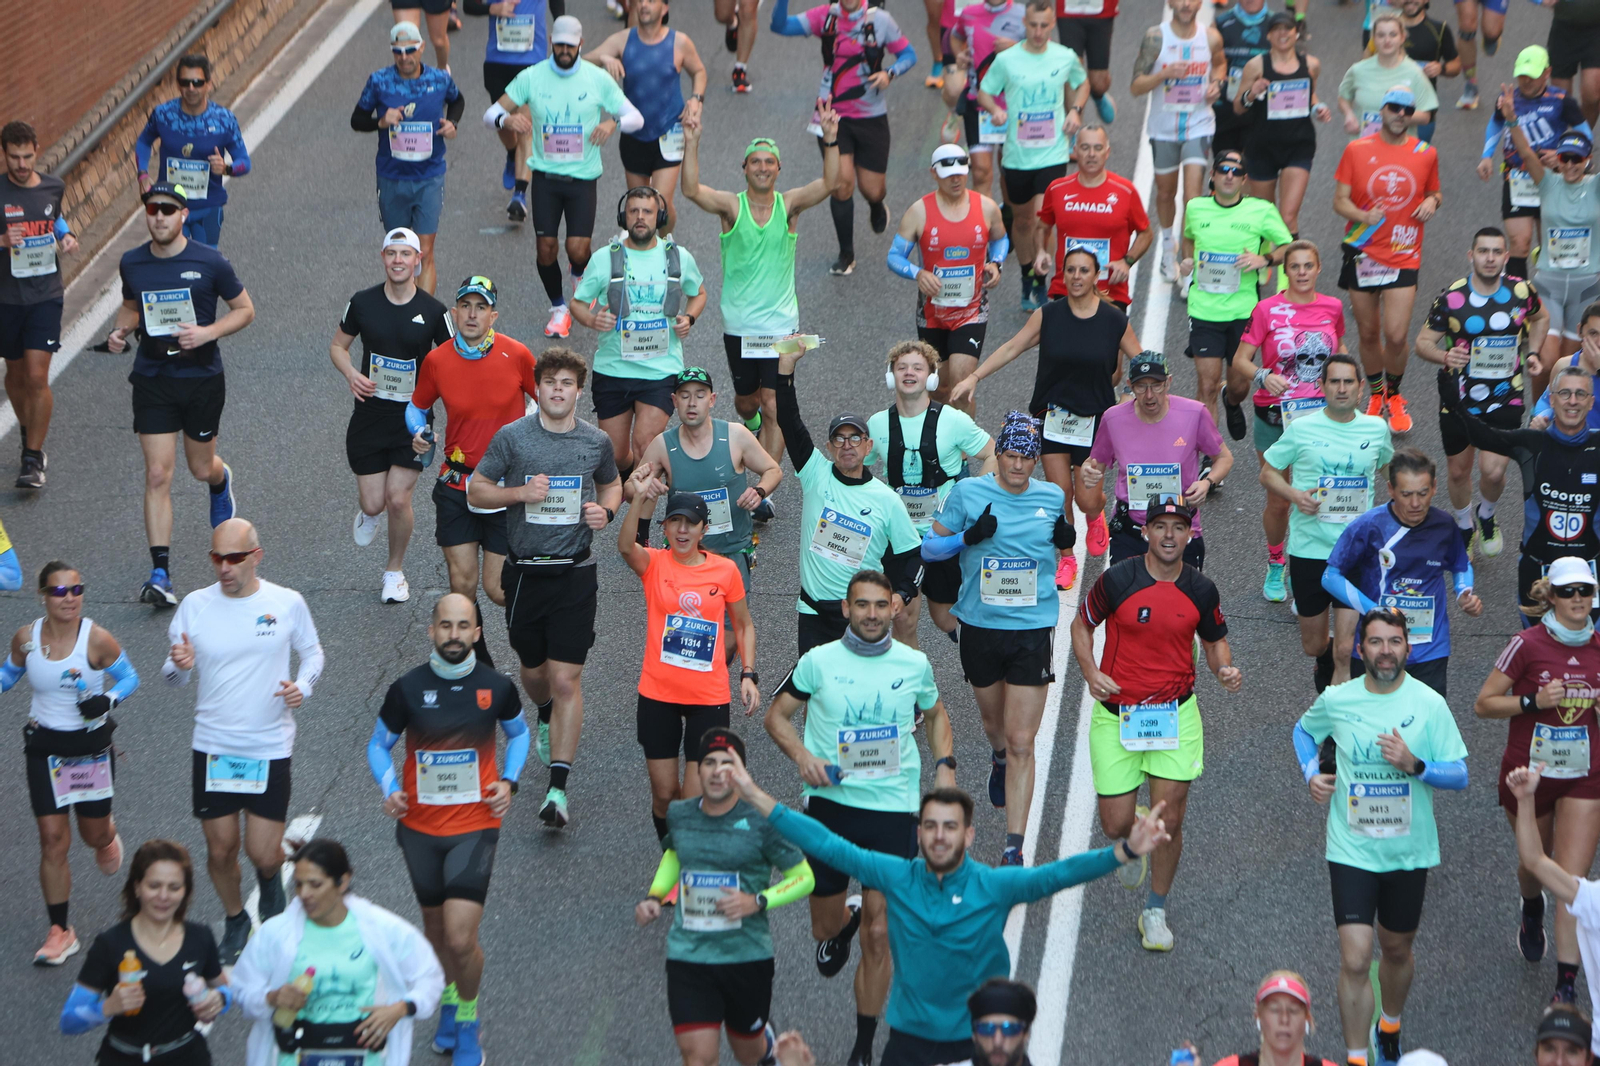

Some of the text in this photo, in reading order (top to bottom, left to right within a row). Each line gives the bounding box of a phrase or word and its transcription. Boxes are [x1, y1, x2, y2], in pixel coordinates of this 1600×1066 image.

[1065, 201, 1113, 214] CANADA
[946, 269, 969, 277] ZURICH
[159, 293, 184, 301] ZURICH
[638, 320, 662, 330] ZURICH
[1489, 338, 1514, 347] ZURICH
[386, 361, 411, 370] ZURICH
[383, 375, 402, 383] 10369
[1145, 466, 1173, 474] ZURICH
[1146, 482, 1162, 490] 9545
[906, 487, 932, 495] ZURICH
[1540, 482, 1592, 505] George
[838, 517, 867, 533] ZURICH
[1553, 515, 1580, 532] 30
[832, 532, 850, 543] 9847
[1001, 577, 1018, 585] 8993
[1400, 600, 1428, 608] ZURICH
[686, 622, 711, 632] ZURICH
[681, 637, 701, 648] 11314
[681, 648, 696, 658] CYCY
[1140, 702, 1170, 710] ZURICH
[1140, 719, 1158, 727] 5299
[859, 729, 891, 740] ZURICH
[860, 749, 879, 757] 9328
[436, 753, 470, 763] ZURICH
[853, 760, 886, 768] ROBEWAN
[1369, 785, 1403, 795] ZURICH
[1369, 805, 1389, 814] 9413
[1357, 817, 1403, 825] JUAN CARLOS
[697, 876, 730, 886] ZURICH
